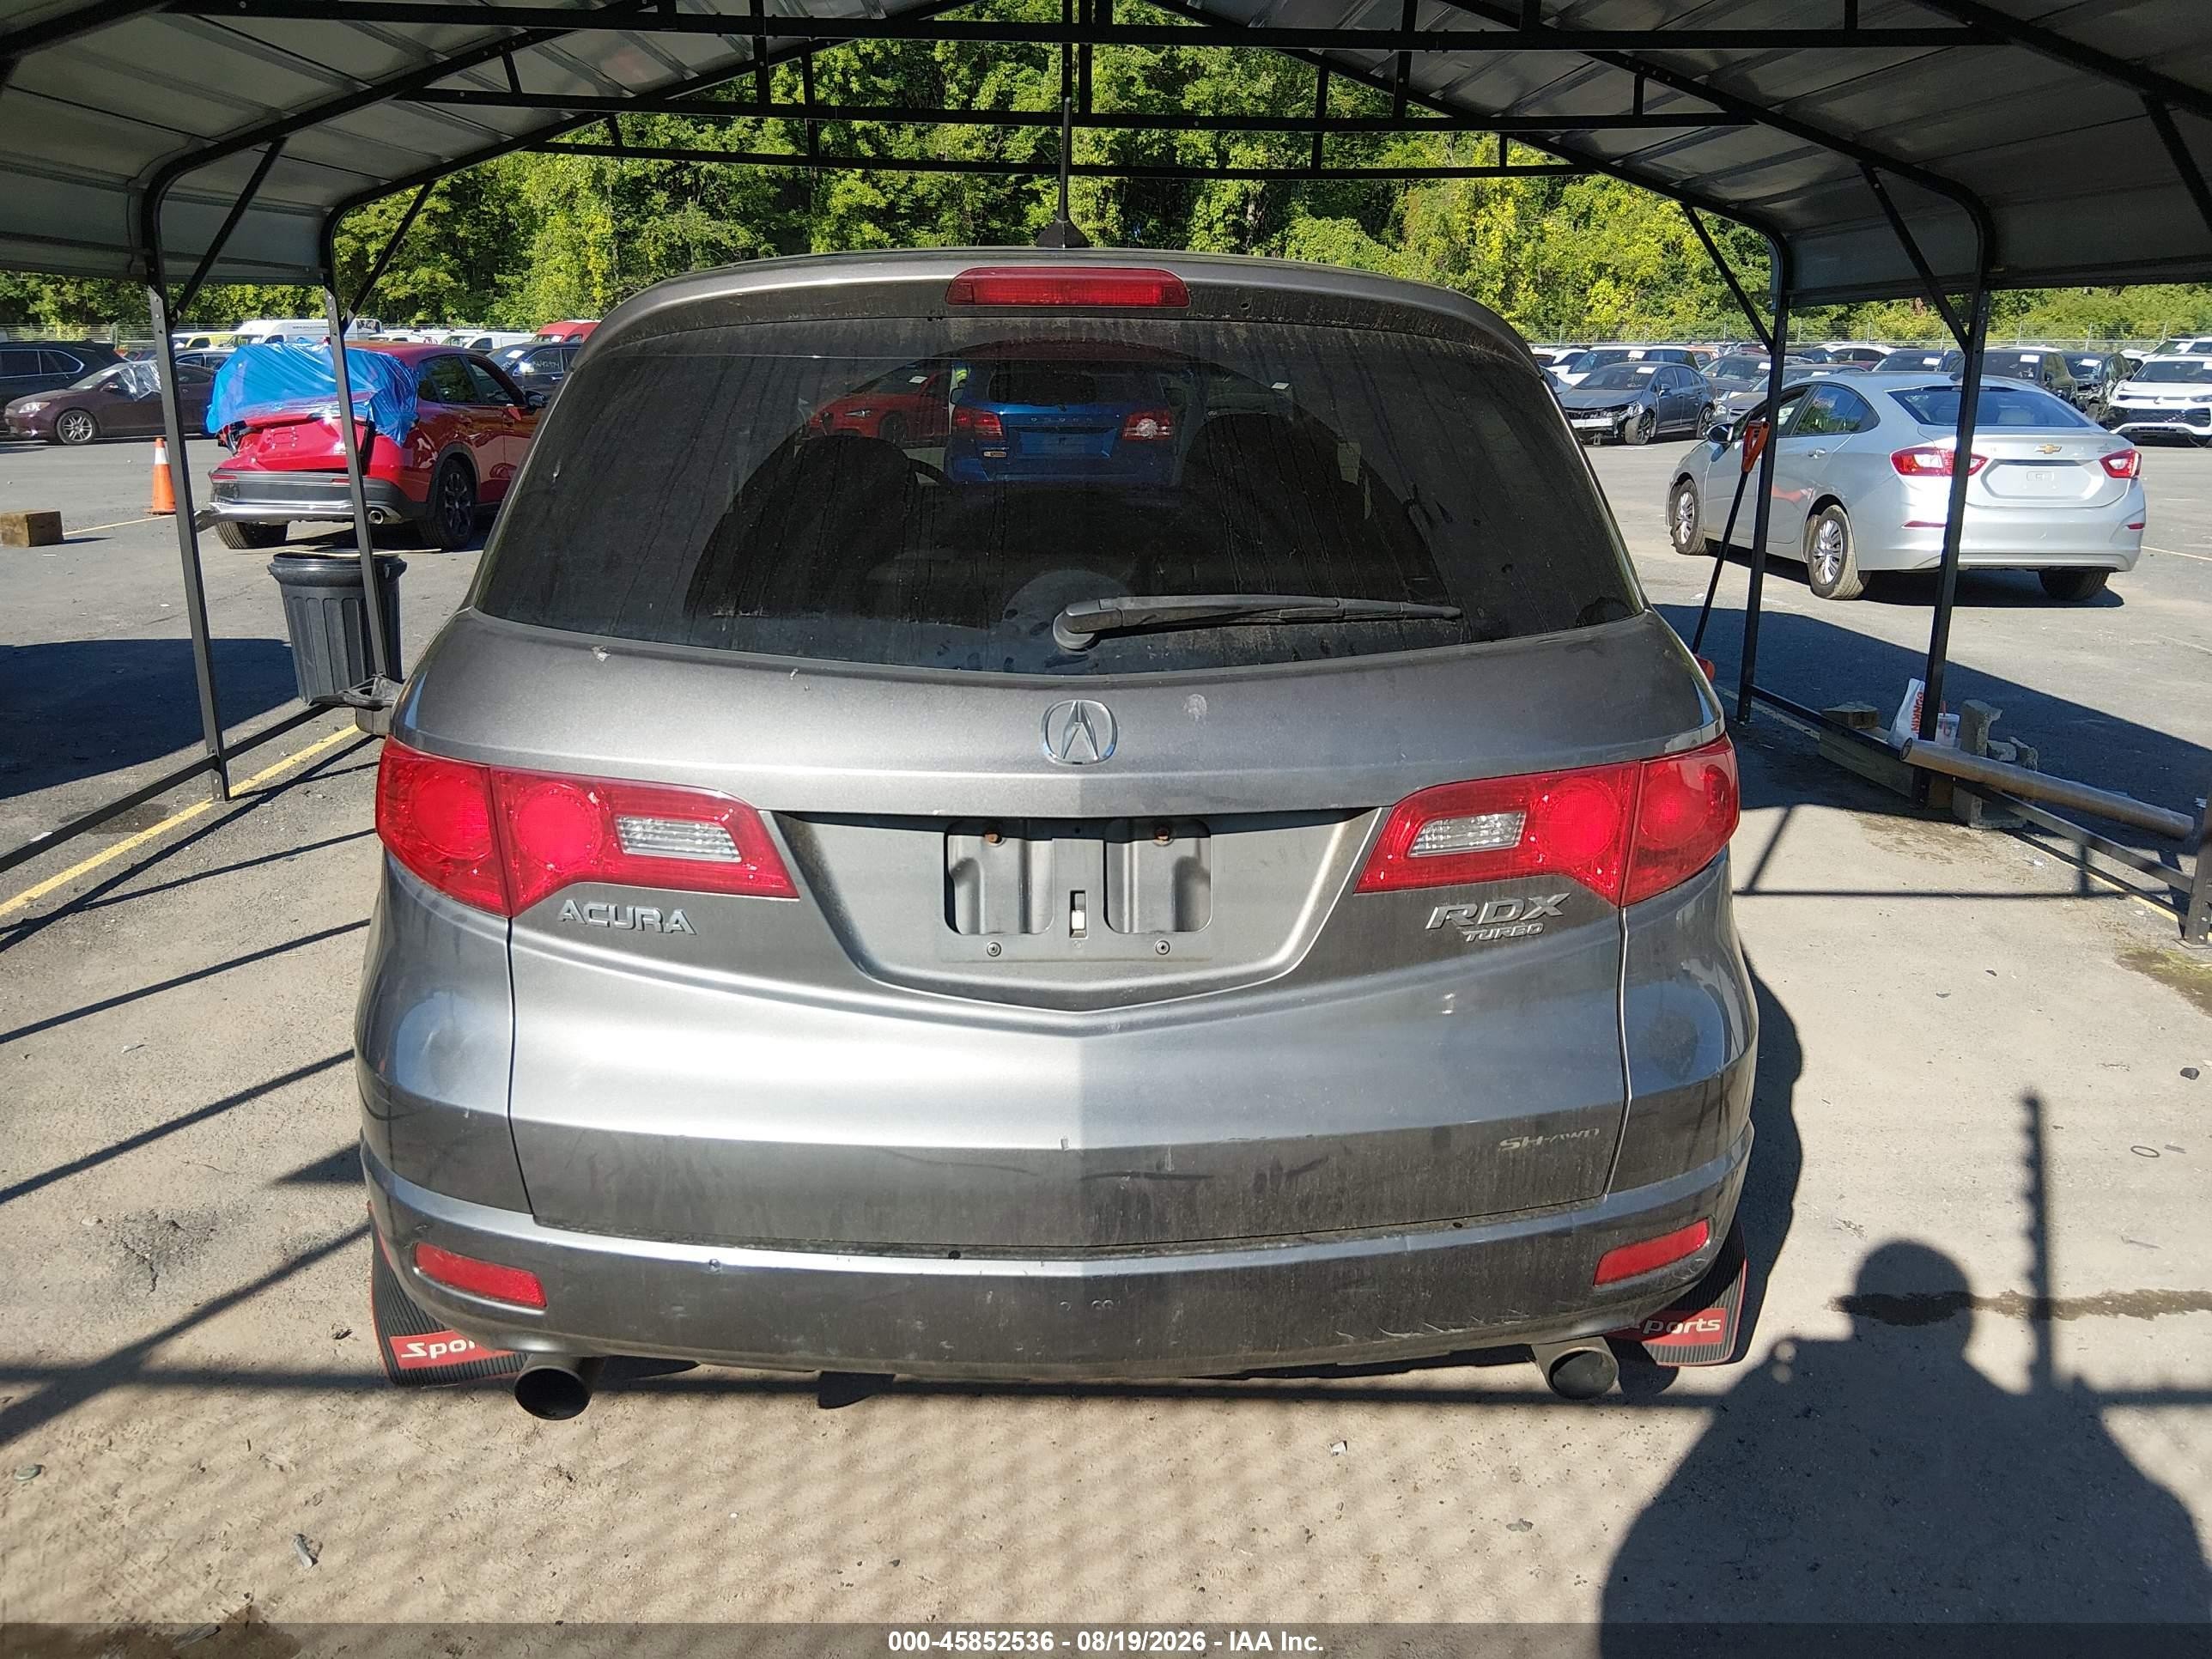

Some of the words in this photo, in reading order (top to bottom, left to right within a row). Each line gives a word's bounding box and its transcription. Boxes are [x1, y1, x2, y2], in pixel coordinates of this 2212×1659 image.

[558, 898, 697, 935] ACURA
[1425, 892, 1571, 930] RDX
[1462, 922, 1544, 942] TURBO
[1641, 1317, 1722, 1335] ports
